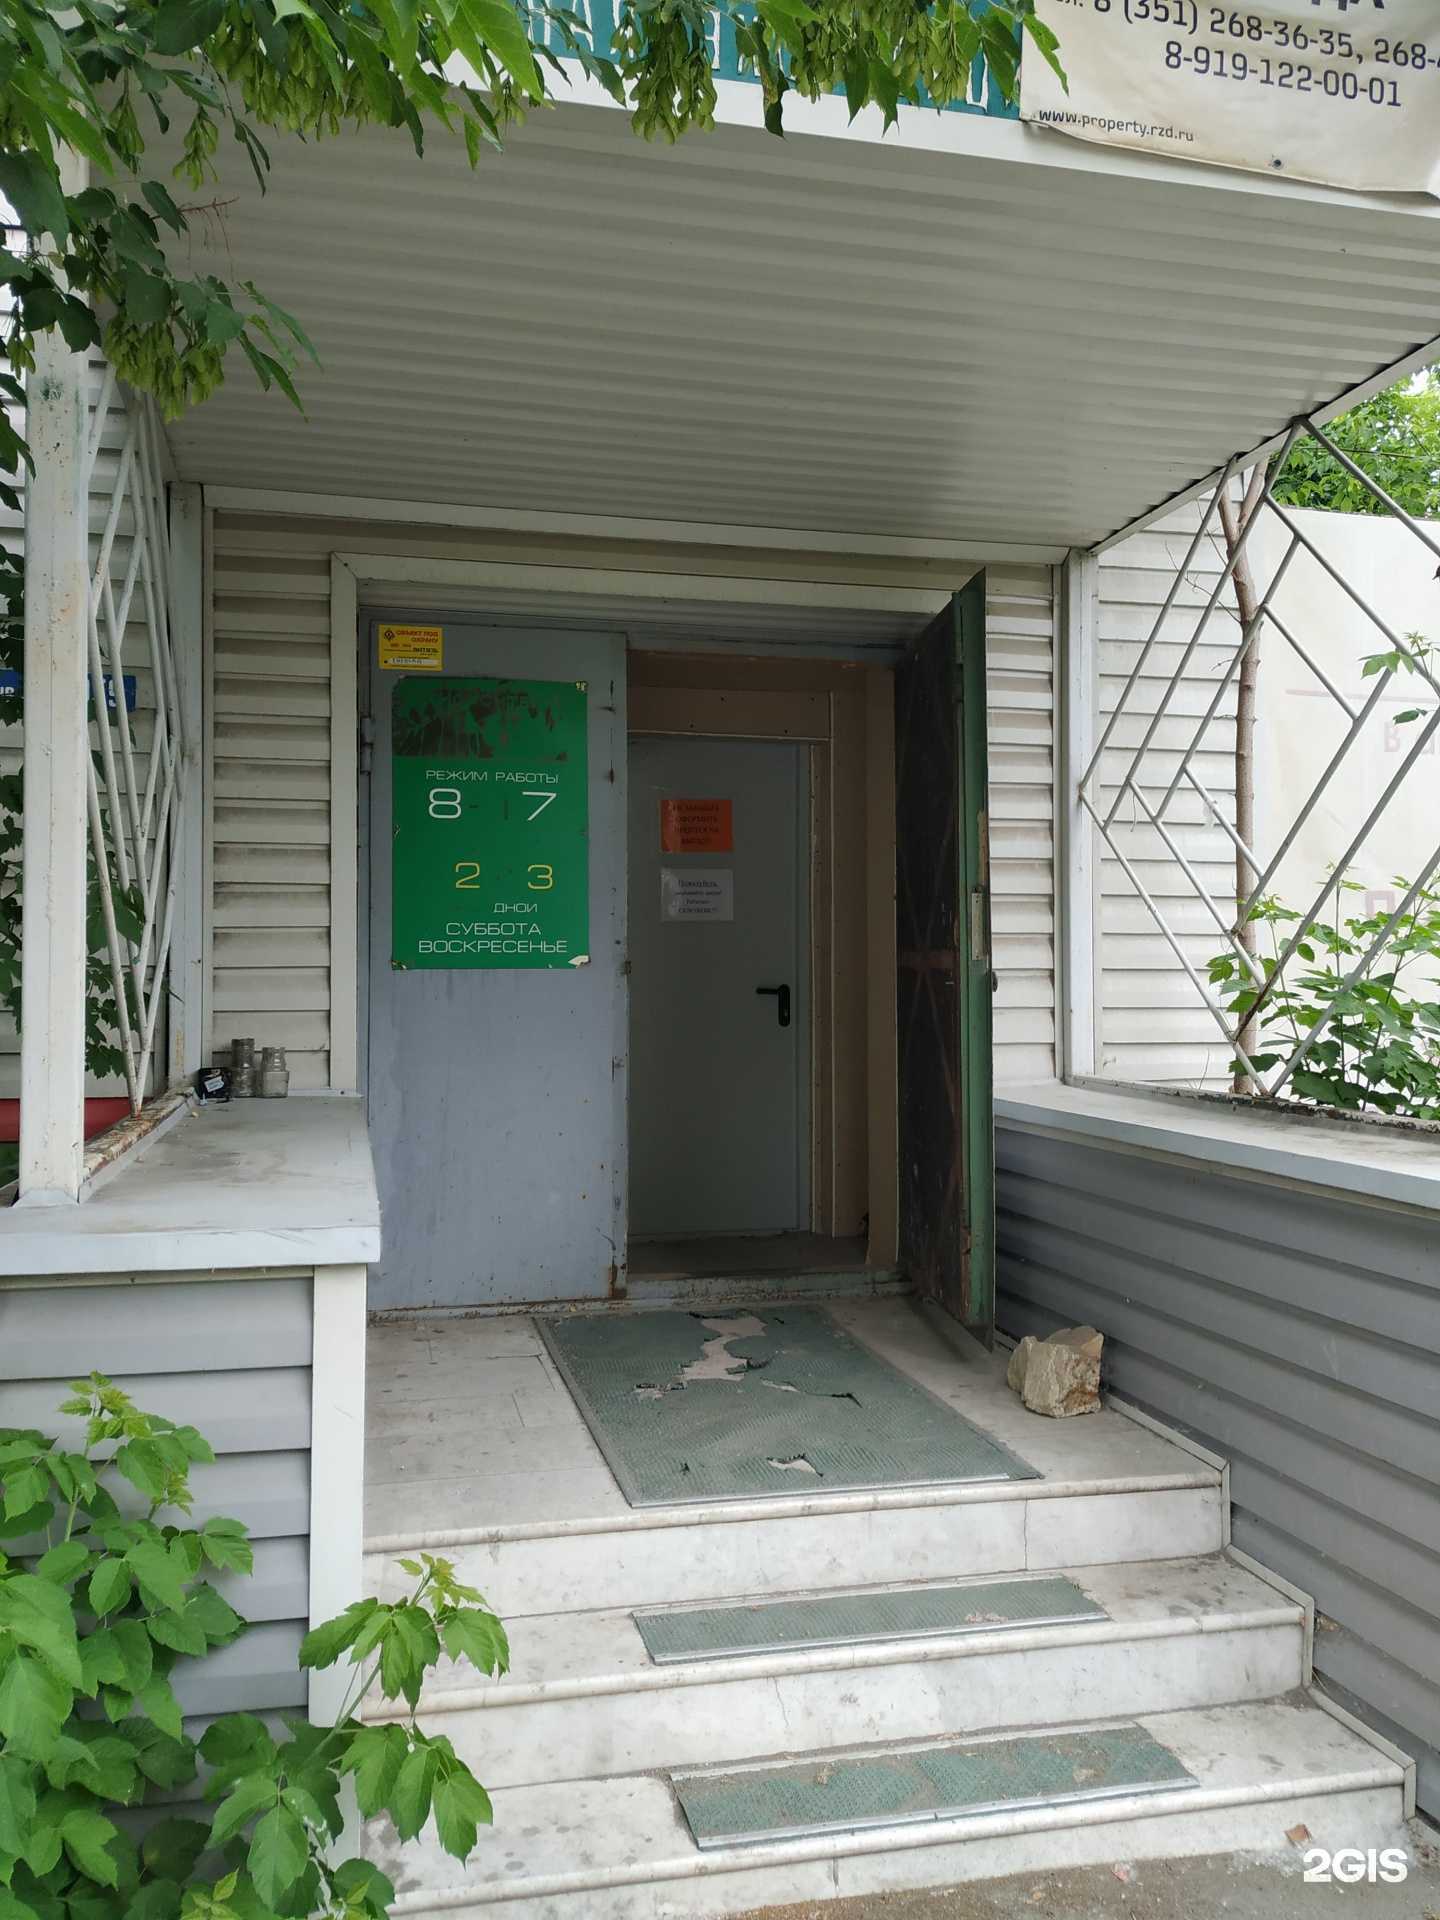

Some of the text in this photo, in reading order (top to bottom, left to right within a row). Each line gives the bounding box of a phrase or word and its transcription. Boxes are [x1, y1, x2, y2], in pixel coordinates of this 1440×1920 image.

[1124, 0, 1197, 35] (351)
[1210, 7, 1363, 64] 268-36-35,
[1374, 38, 1440, 69] 268-
[1165, 40, 1402, 107] 8-919-122-00-01
[1038, 109, 1195, 142] www.property.rzd.ru
[425, 770, 560, 784] РЕЖИМ РАБОТЫ
[428, 788, 462, 819] 8
[454, 861, 554, 890] 2 3
[446, 922, 542, 936] СУББОТА
[418, 940, 568, 954] ВОСКРЕСЕНЬЕ
